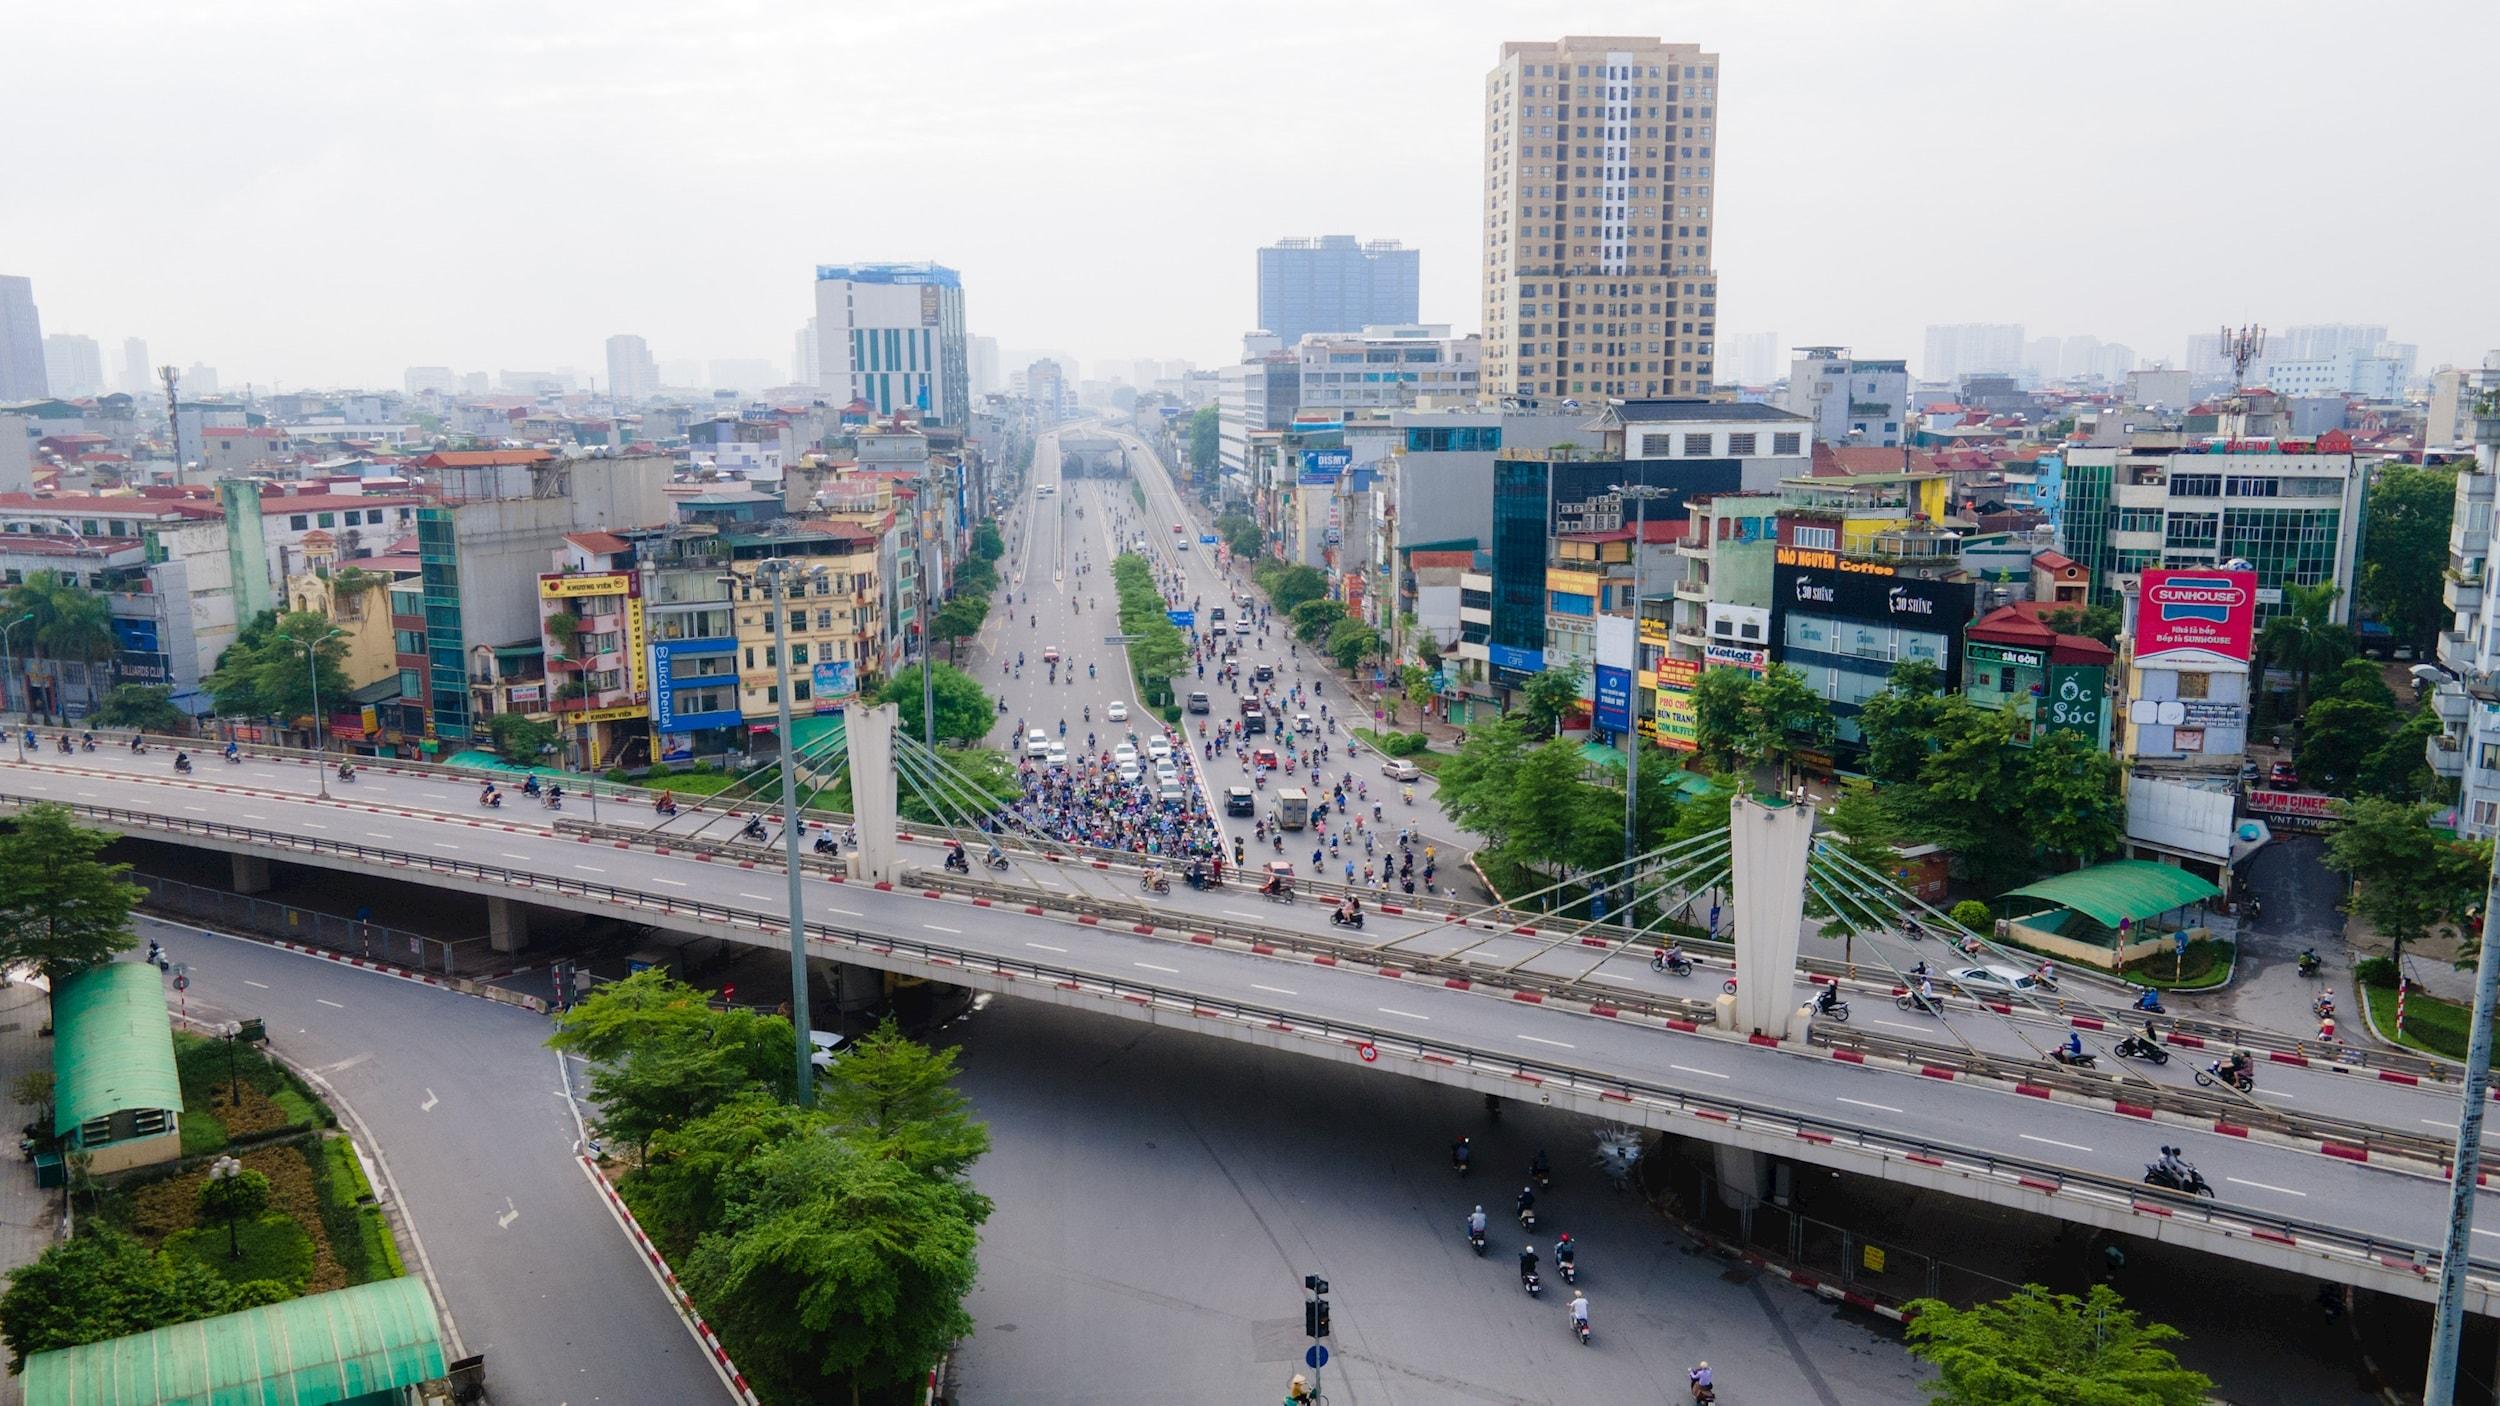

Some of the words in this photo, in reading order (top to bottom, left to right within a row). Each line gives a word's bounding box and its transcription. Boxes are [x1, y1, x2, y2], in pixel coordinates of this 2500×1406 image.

[1318, 455, 1347, 465] DISMY
[1839, 560, 1895, 576] Coffee
[2159, 590, 2236, 602] SUNHOUSE
[2199, 624, 2216, 635] bếp
[2156, 632, 2173, 643] Bếp
[2183, 635, 2231, 645] SUNHOUSE
[1707, 646, 1752, 661] Vietlott
[2060, 672, 2092, 702] Ốc
[660, 691, 672, 728] Dental
[2052, 702, 2096, 724] Sóc
[2270, 815, 2290, 825] VNT
